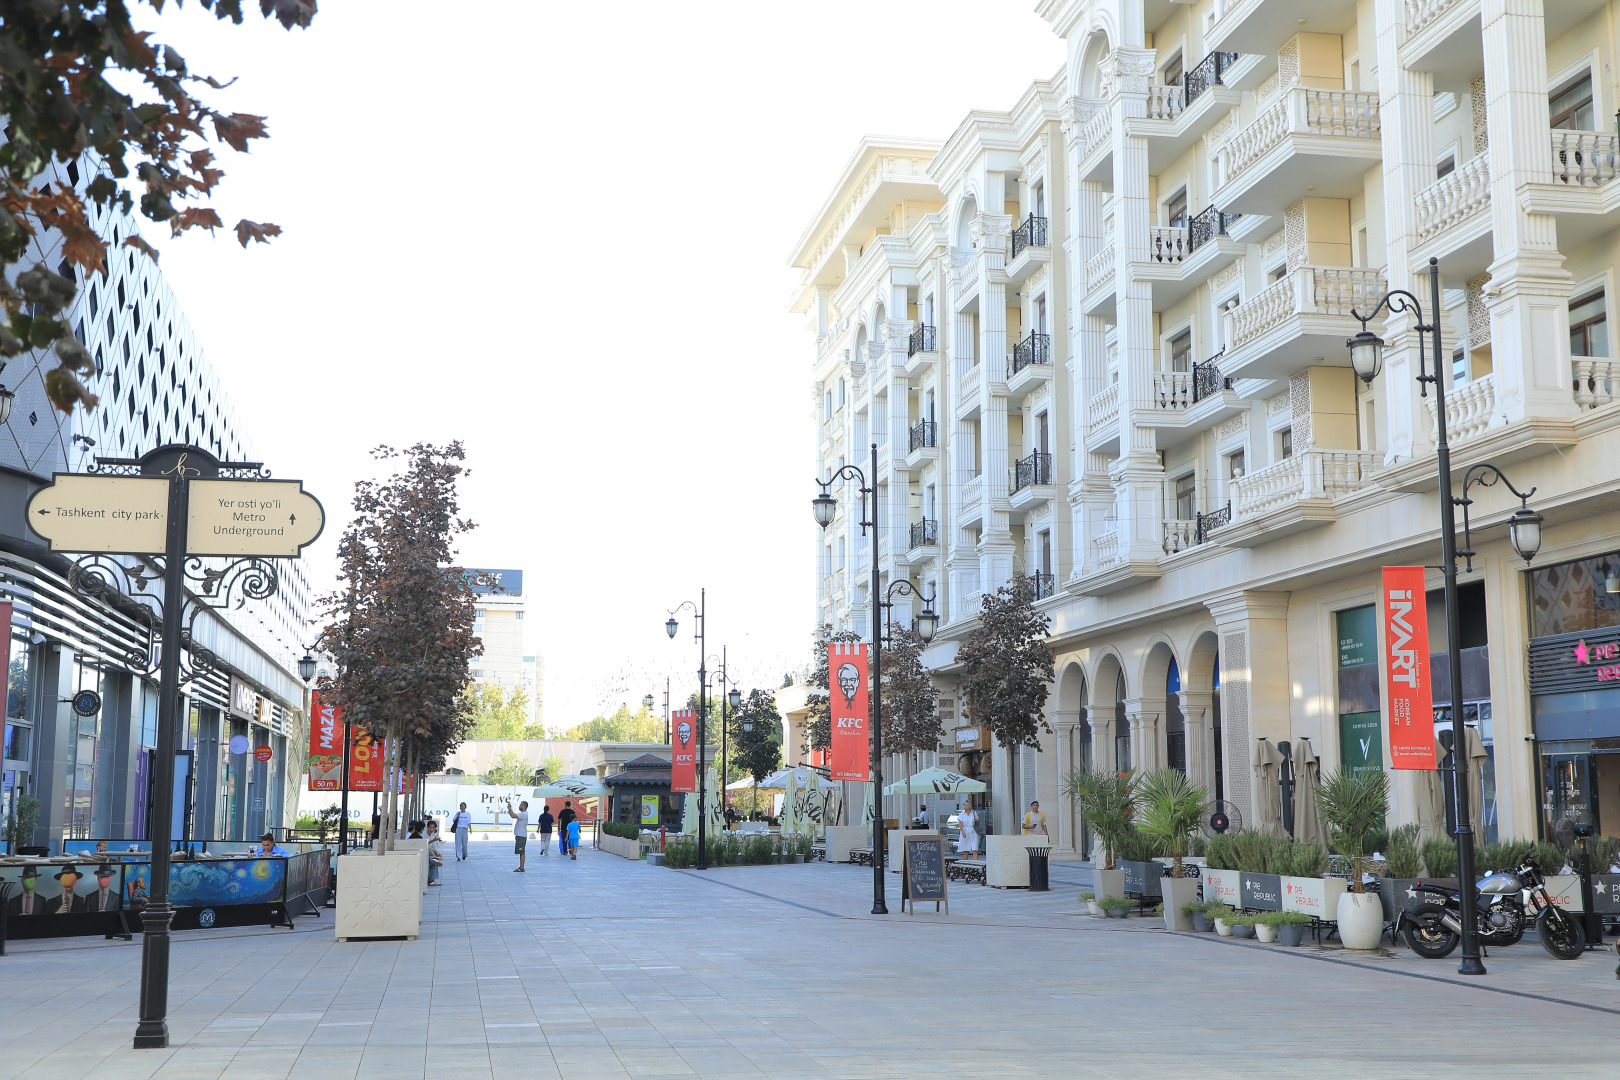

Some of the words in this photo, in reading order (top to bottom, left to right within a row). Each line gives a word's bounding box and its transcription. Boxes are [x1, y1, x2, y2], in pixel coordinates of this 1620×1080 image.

[218, 498, 235, 508] Yer
[238, 499, 257, 509] osti
[259, 499, 281, 510] yo'li
[56, 506, 105, 518] Tashkent
[112, 509, 132, 521] city
[135, 509, 160, 522] park
[233, 512, 266, 522] Metro
[213, 525, 284, 537] Underground
[319, 703, 335, 749] MAZA
[836, 717, 863, 729] KFC
[675, 754, 693, 762] KFC
[481, 793, 512, 803] Prvé
